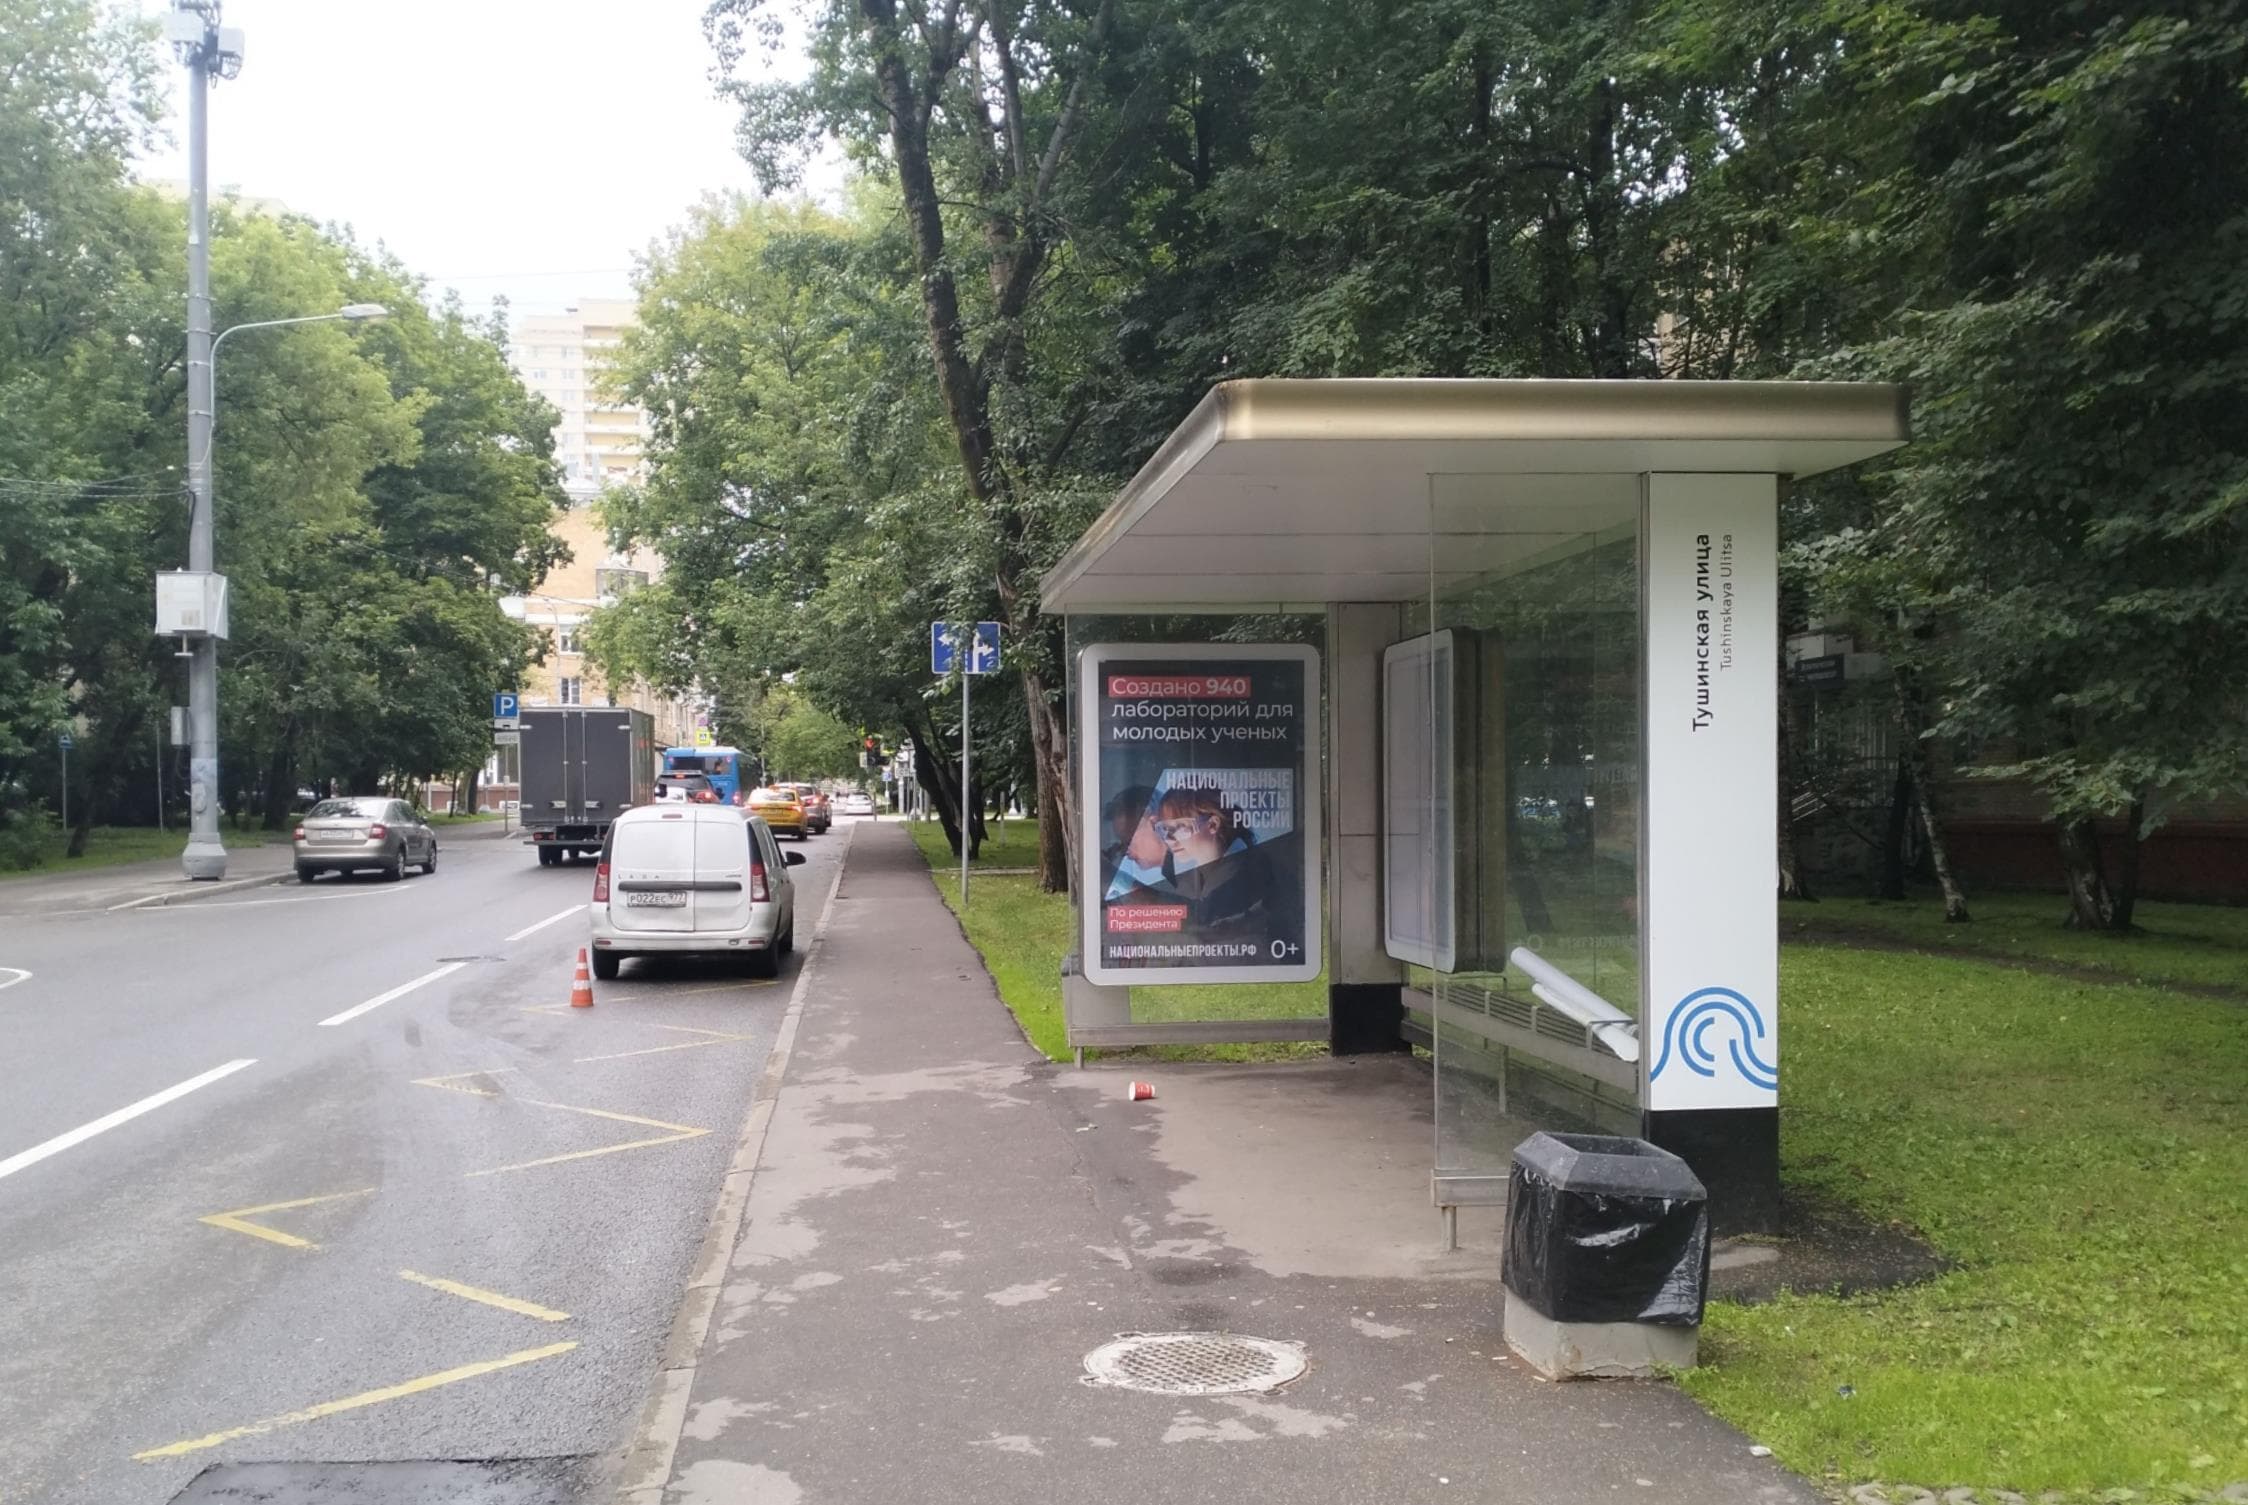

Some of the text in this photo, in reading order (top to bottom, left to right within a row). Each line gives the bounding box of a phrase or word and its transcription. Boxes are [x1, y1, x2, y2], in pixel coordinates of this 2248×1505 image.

[1720, 534, 1733, 671] Tushinskaya Ulitsa
[1693, 534, 1713, 731] Тушинская улица
[1112, 677, 1247, 696] Создано 940
[1112, 700, 1294, 720] лабораторий для
[1112, 725, 1287, 743] молодых ученых
[1166, 772, 1291, 790] НАЦИОНАЛЬНЫЕ
[1220, 793, 1290, 809] ПРОЕКТЫ
[1233, 811, 1291, 829] РОССИИ
[1110, 908, 1184, 920] По решению
[1110, 919, 1178, 931] Президента
[1110, 940, 1299, 960] НАЦИОНАЛЬНЫЕПРОЕКТЫ.РФ 0+
